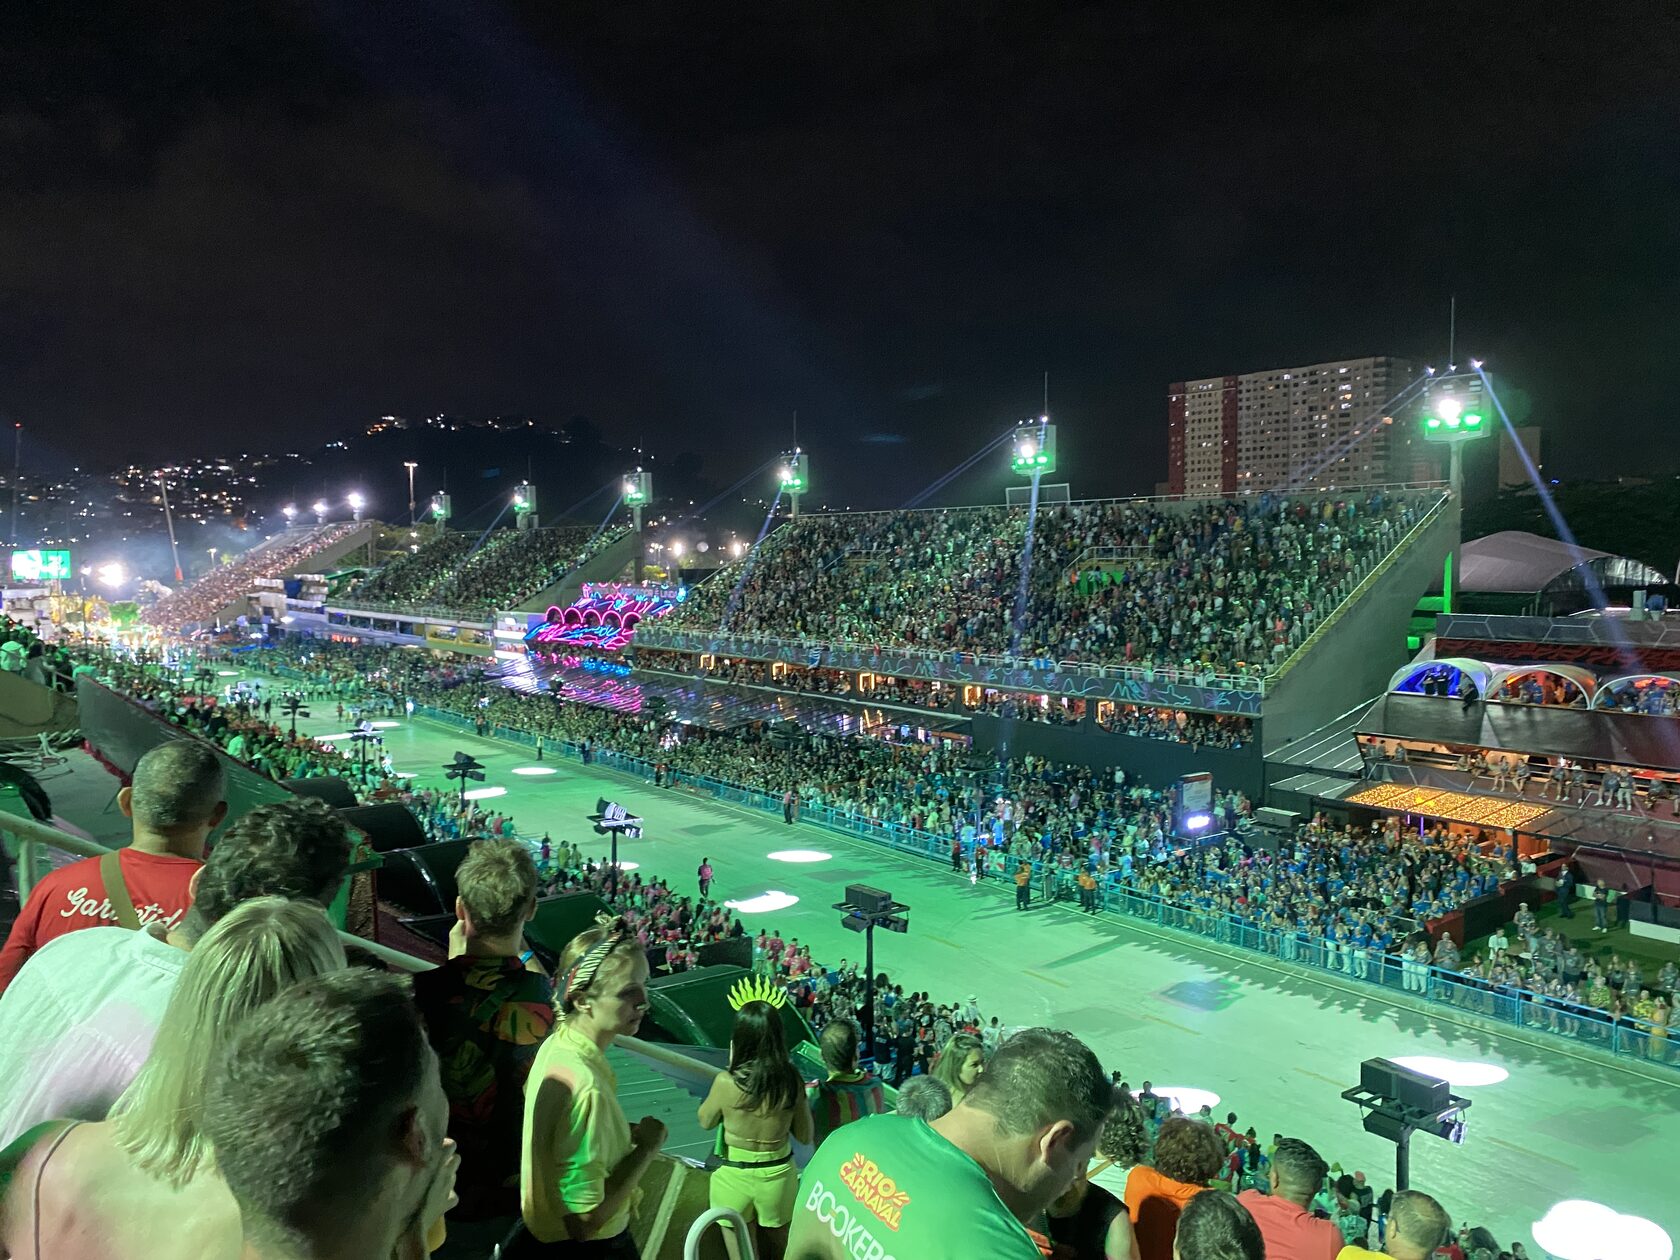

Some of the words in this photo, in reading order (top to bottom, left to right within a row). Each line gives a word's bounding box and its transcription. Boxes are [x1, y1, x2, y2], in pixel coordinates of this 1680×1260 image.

[839, 1161, 901, 1229] CARNAVAL
[860, 1159, 896, 1198] RIO
[805, 1180, 897, 1260] BOOKER
